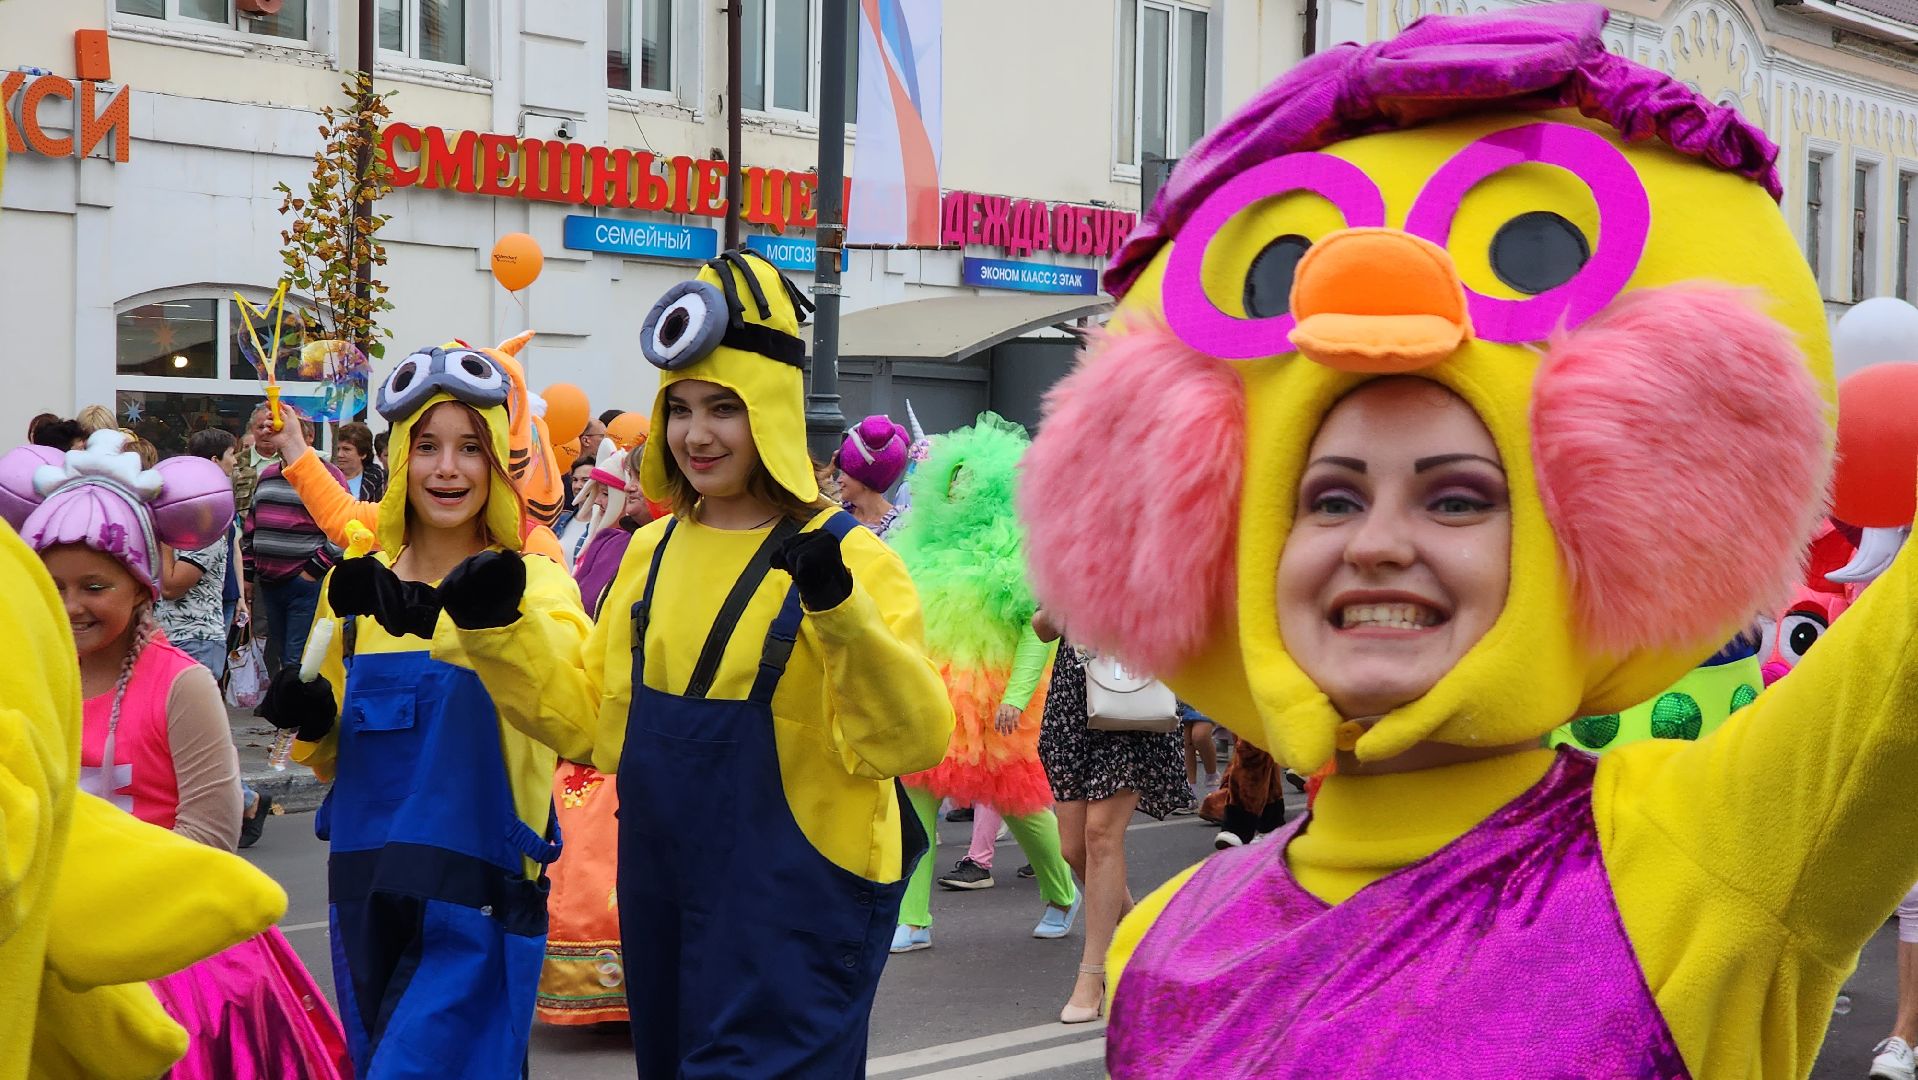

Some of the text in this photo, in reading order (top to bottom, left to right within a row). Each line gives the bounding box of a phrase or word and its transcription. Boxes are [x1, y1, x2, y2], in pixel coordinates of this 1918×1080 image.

[379, 122, 852, 235] СМЕШНЫЕ ЦЕ
[595, 224, 691, 251] семейный
[942, 190, 1051, 257] ДЕЖДА
[980, 266, 1082, 287] ЭКОНОМ КЛАСС 2 ЭТАЖ
